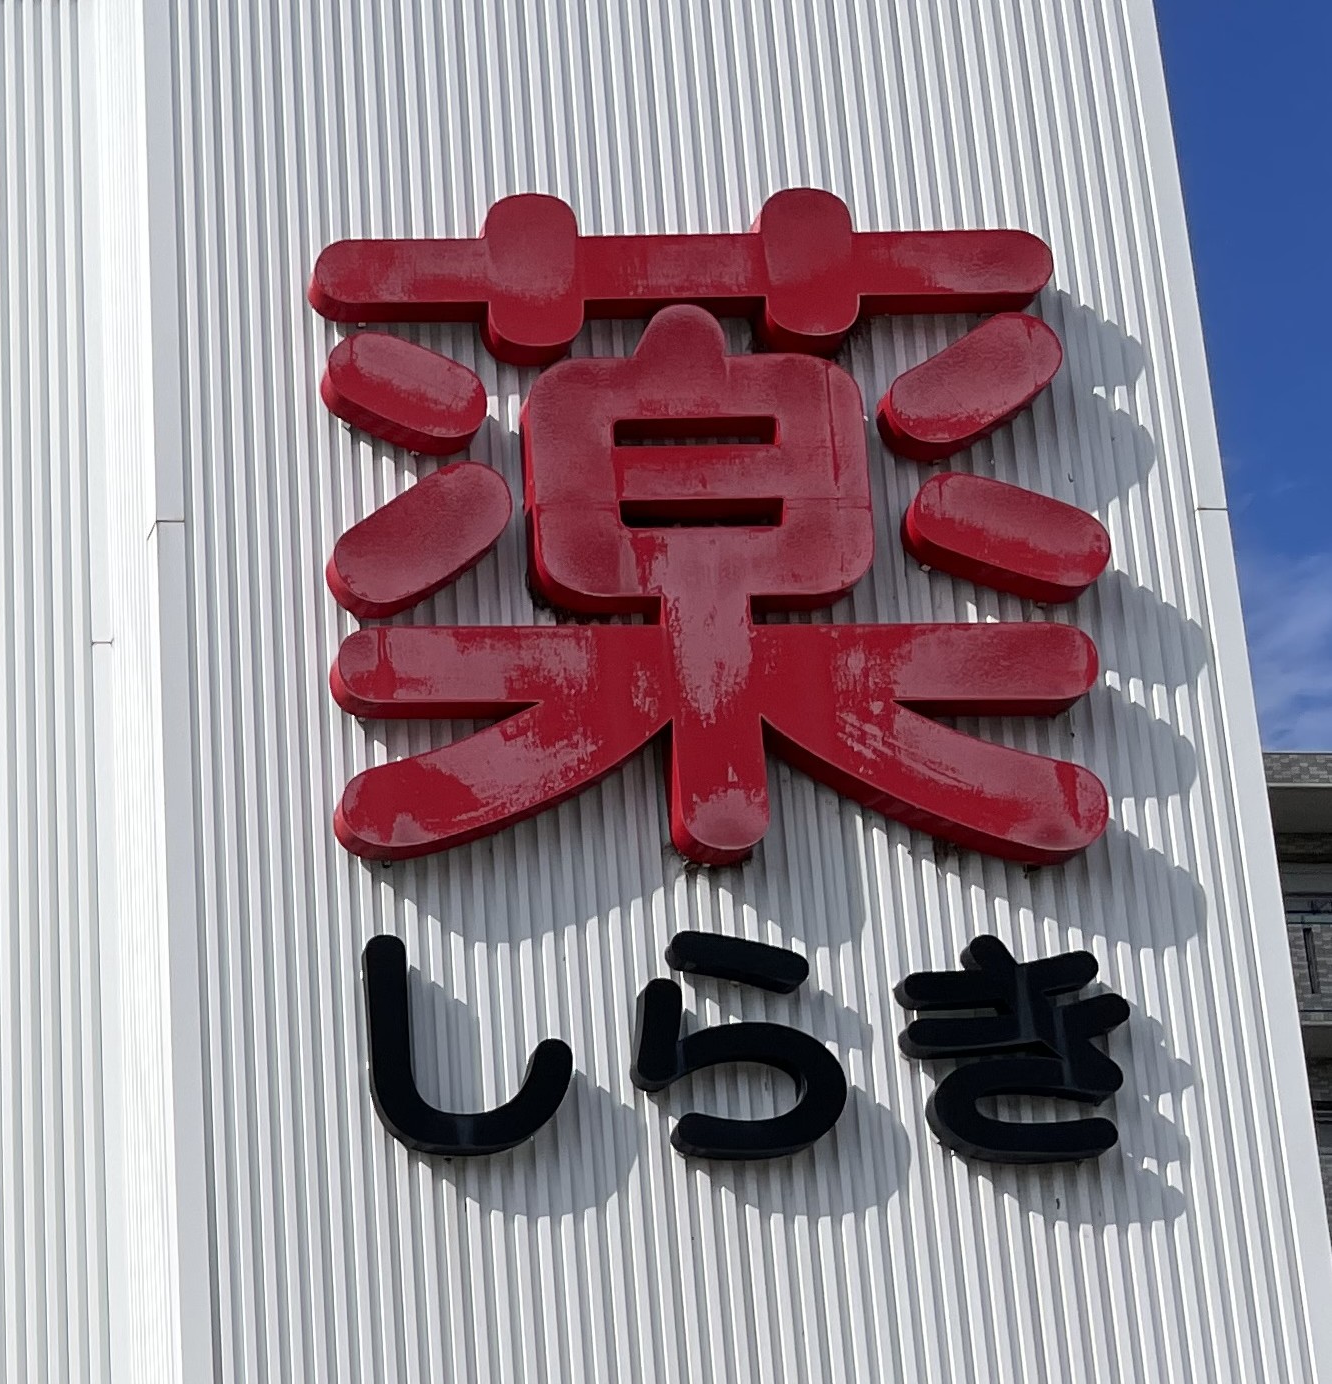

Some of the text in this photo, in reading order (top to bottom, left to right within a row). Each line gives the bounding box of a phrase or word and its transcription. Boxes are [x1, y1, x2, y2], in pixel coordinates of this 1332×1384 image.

[308, 187, 1111, 866] 薬
[360, 931, 1131, 1164] しらき
